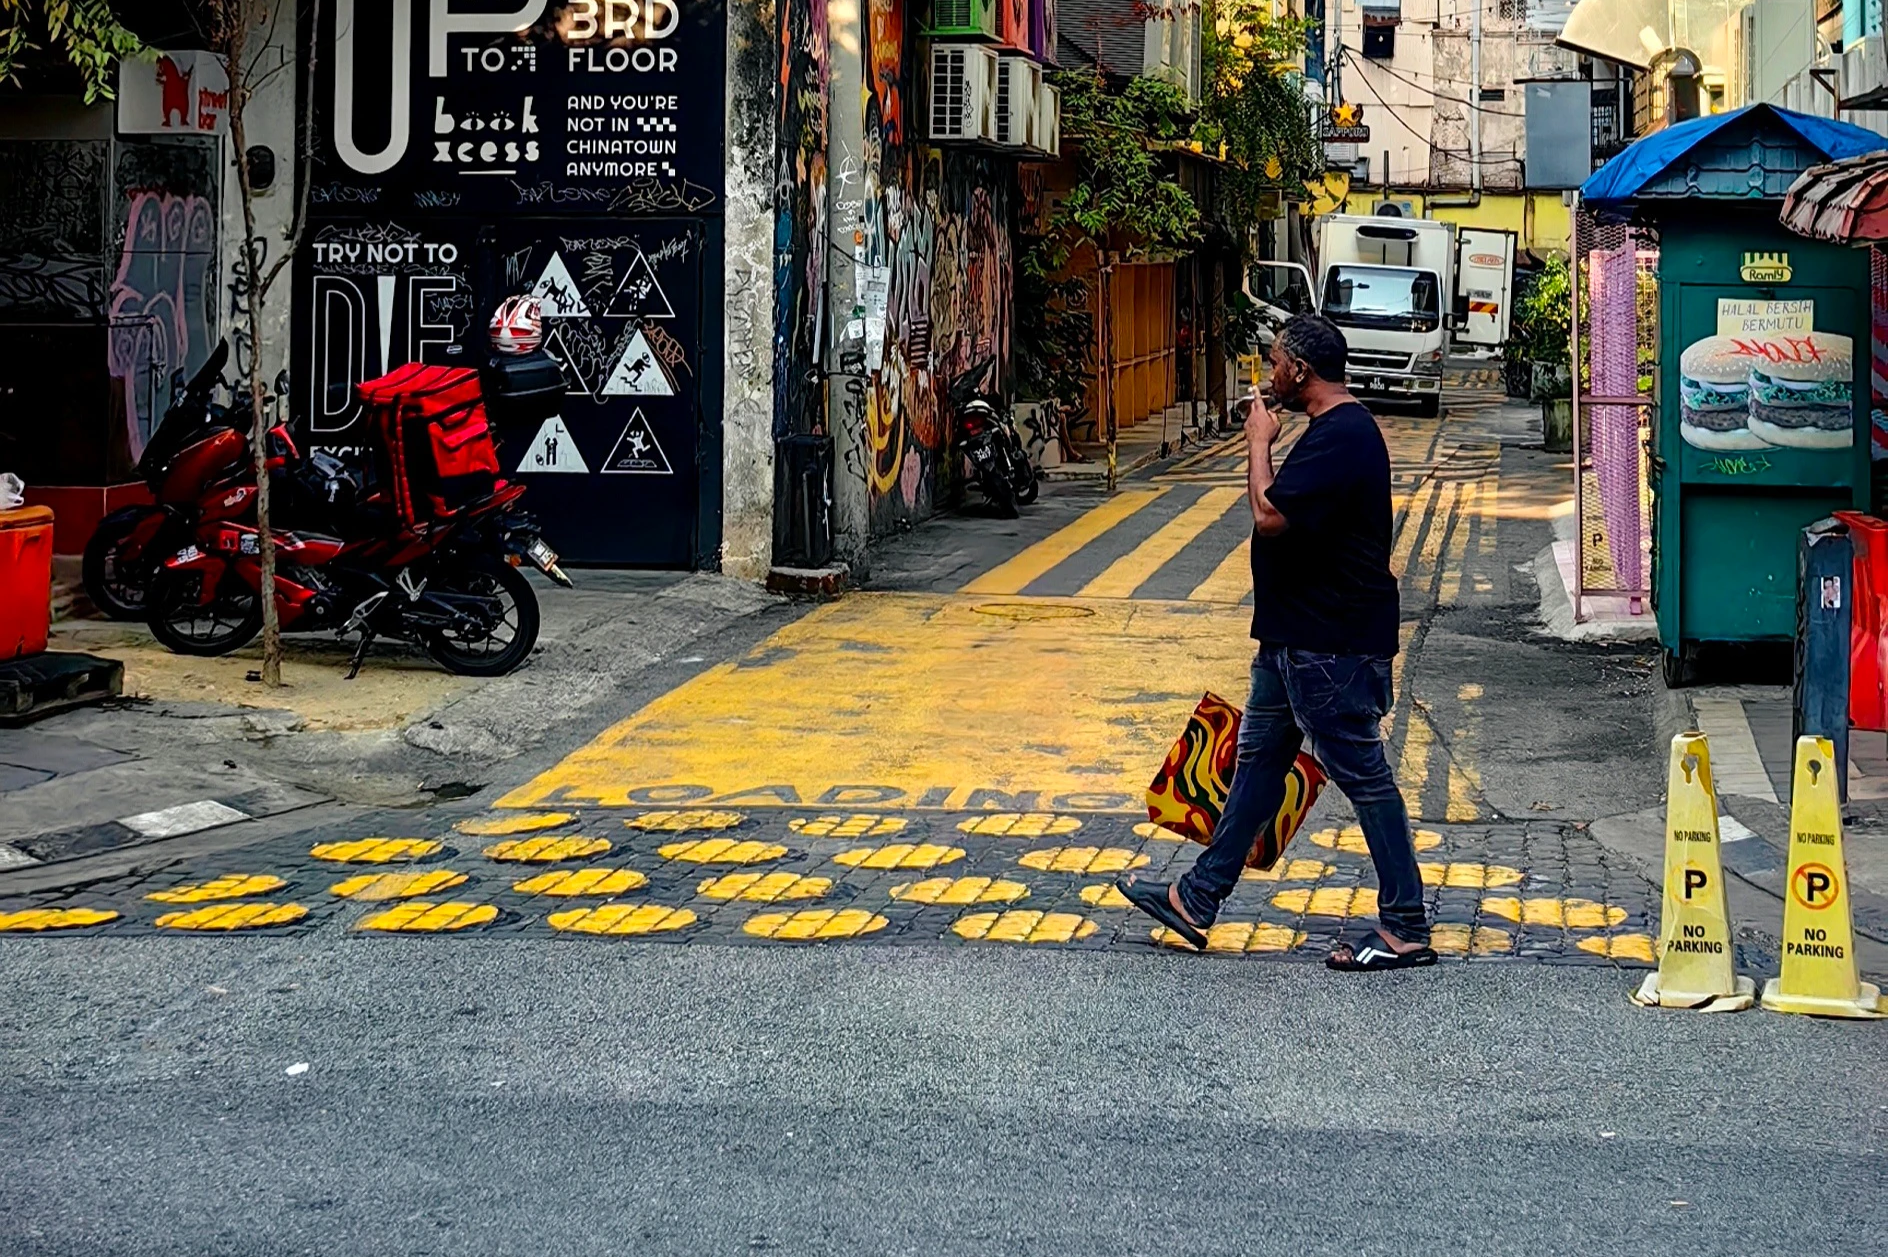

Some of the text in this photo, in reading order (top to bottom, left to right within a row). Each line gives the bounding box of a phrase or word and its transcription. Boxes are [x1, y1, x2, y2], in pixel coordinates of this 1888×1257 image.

[461, 47, 505, 72] TO
[568, 47, 679, 73] FLOOR
[567, 95, 679, 110] AND YOU'RE
[567, 117, 630, 132] NOT IN
[567, 139, 677, 154] CHINATOWN
[567, 162, 658, 177] ANYMORE
[312, 243, 458, 264] TRY NOT TO
[1722, 300, 1813, 316] HALAL BERSIH
[1742, 317, 1804, 331] BERMUTU
[1674, 830, 1711, 843] NO PARKING
[1797, 832, 1835, 846] NO PARKING
[1685, 869, 1707, 900] P
[1807, 872, 1830, 902] P
[1683, 925, 1705, 938] NO
[1804, 928, 1827, 941] NO
[1667, 940, 1723, 954] PARKING
[1787, 943, 1844, 959] PARKING
